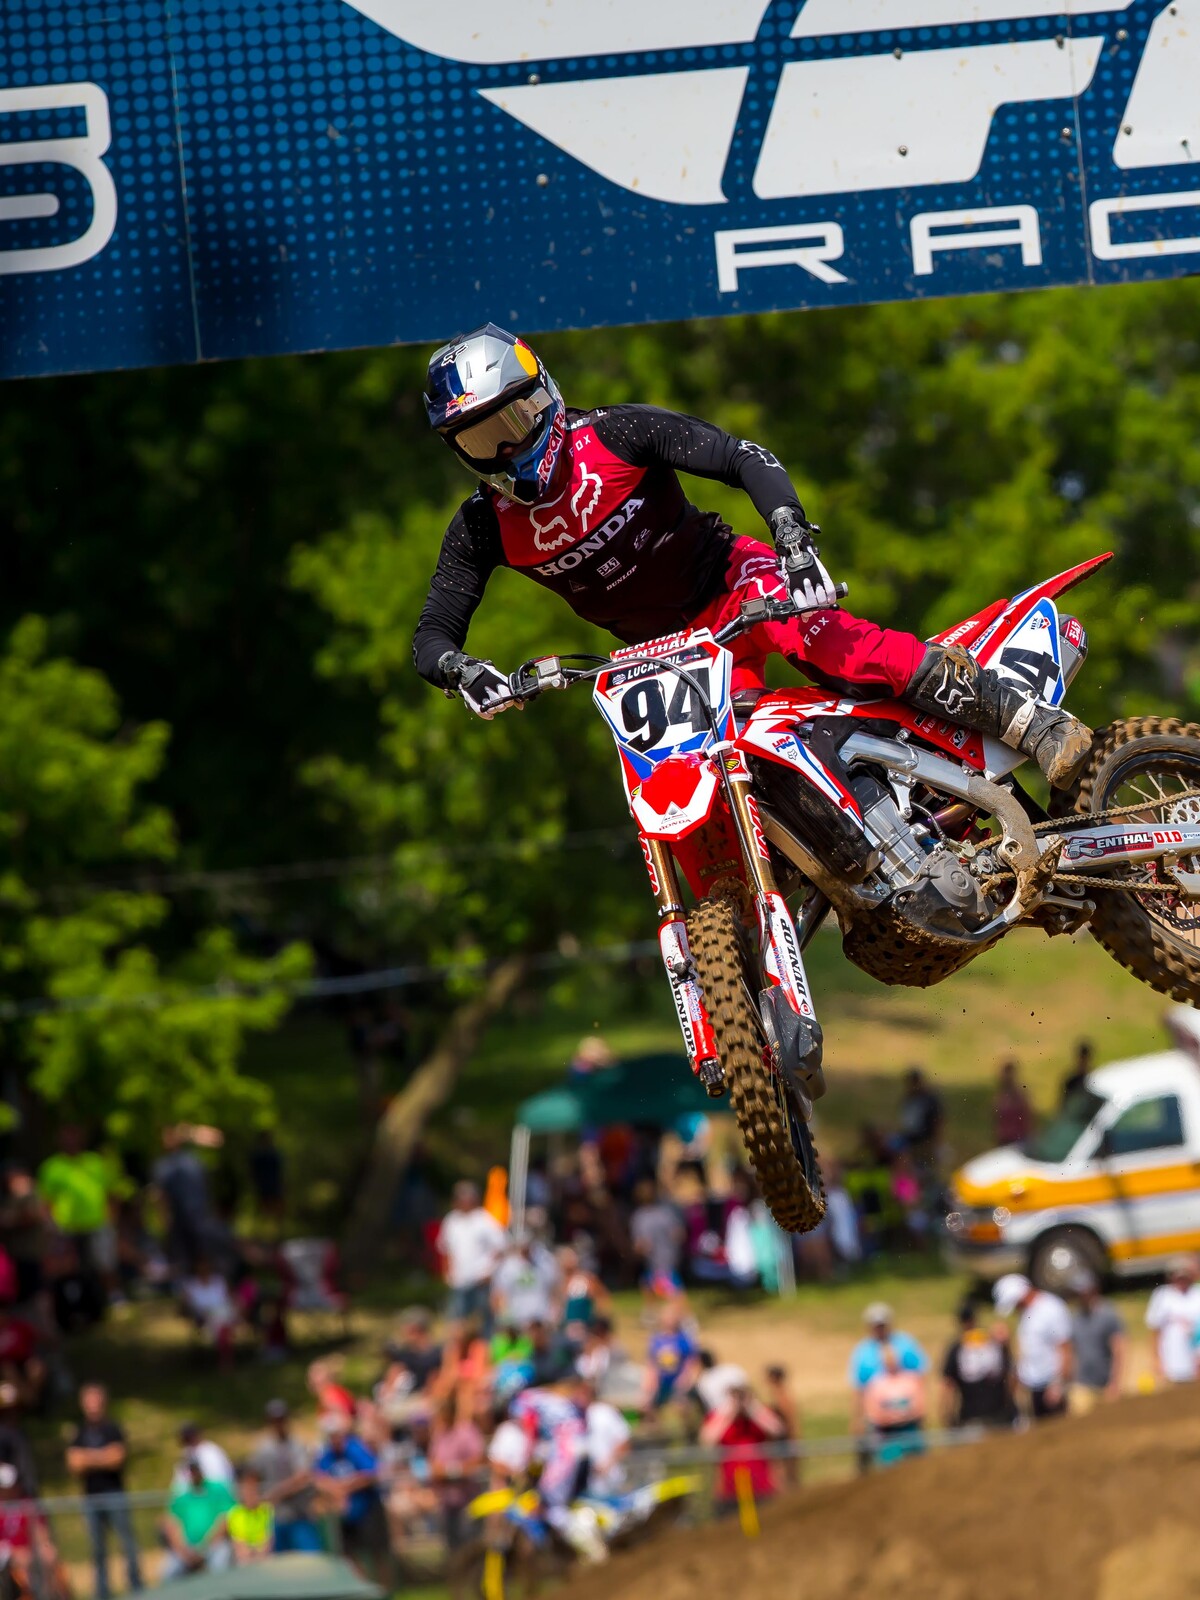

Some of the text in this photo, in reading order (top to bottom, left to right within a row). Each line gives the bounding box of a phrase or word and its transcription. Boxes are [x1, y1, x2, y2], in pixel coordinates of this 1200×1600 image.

[537, 426, 564, 484] Red
[568, 434, 592, 458] FOX
[533, 497, 646, 577] HONDA
[606, 564, 638, 592] DUNLOP
[803, 616, 830, 647] FOX
[998, 647, 1061, 698] 4
[620, 667, 718, 754] 94
[771, 735, 796, 753] HRC
[659, 818, 692, 832] HONDA
[780, 918, 807, 998] DUNLOP
[670, 975, 696, 1052] DUNLOP
